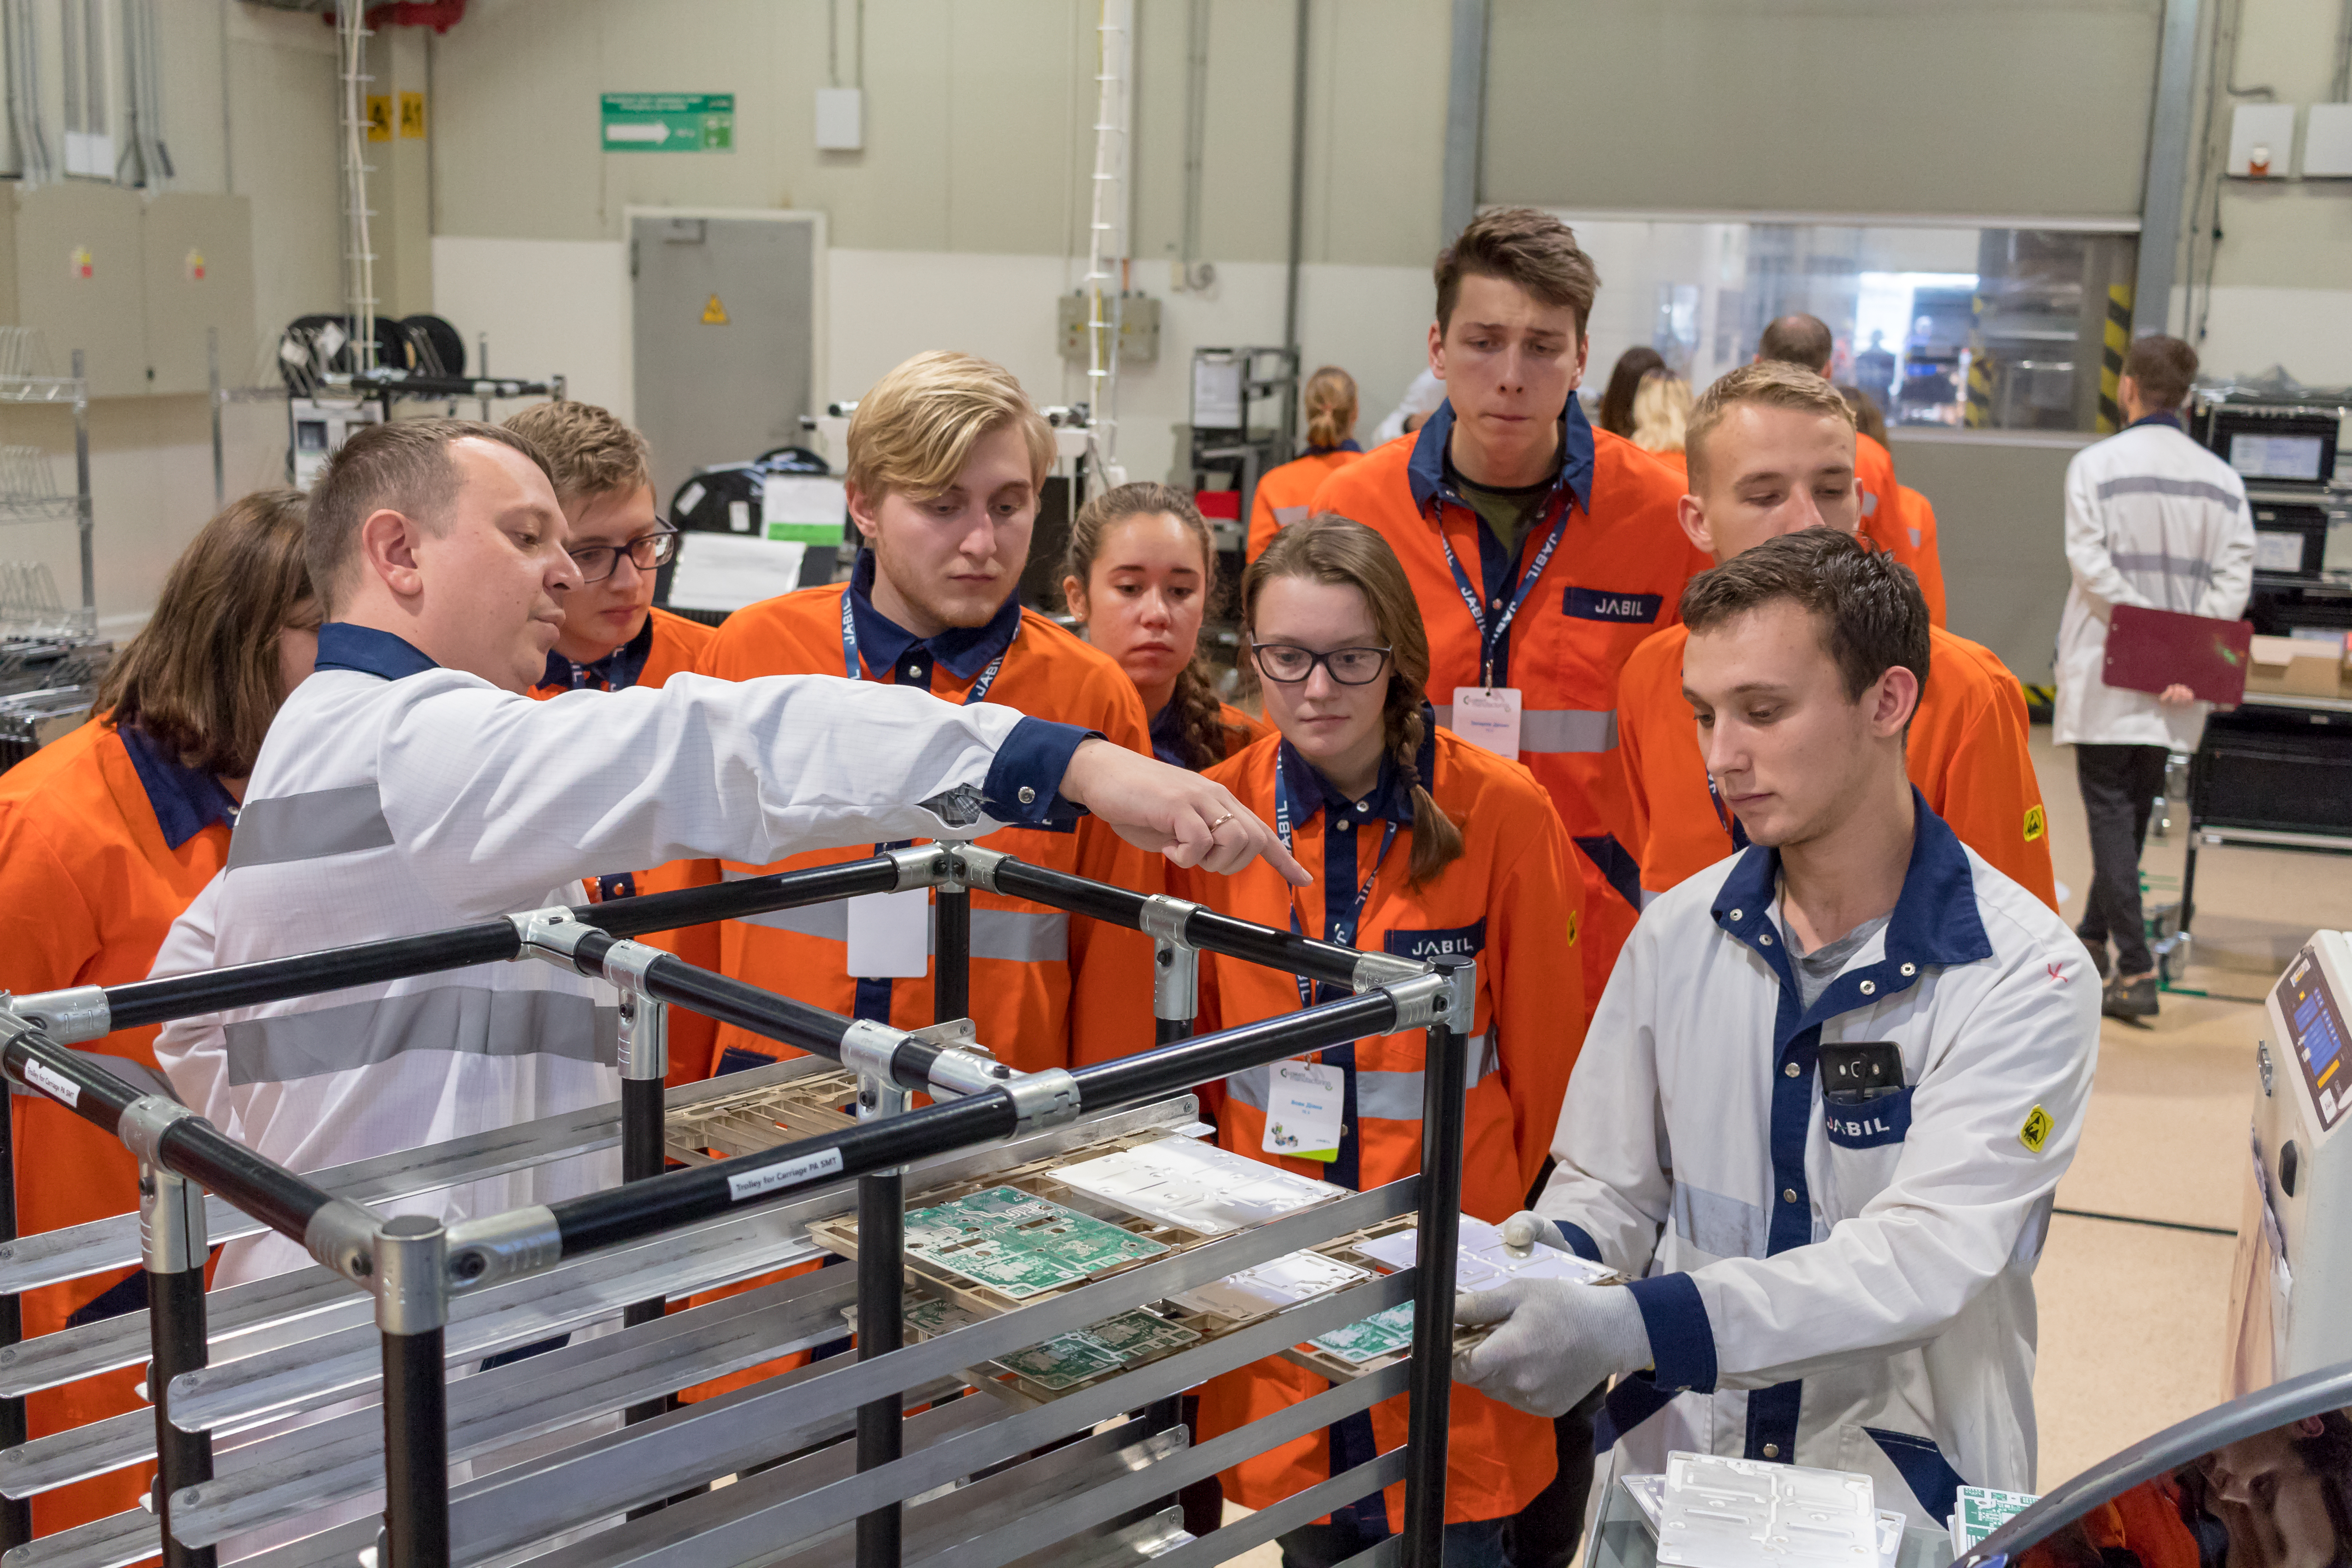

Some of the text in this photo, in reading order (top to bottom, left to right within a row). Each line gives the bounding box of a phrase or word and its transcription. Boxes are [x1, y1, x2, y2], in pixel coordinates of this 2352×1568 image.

[1525, 532, 1557, 579] JABIL
[843, 597, 856, 645] JABIL
[1460, 587, 1486, 635] JABIL
[1595, 598, 1643, 616] JABIL
[1277, 800, 1292, 857] ABIL
[1412, 937, 1474, 956] JABIL
[1827, 1116, 1890, 1136] JABIL
[736, 1156, 838, 1191] Trolley for Carriage PA SMT
